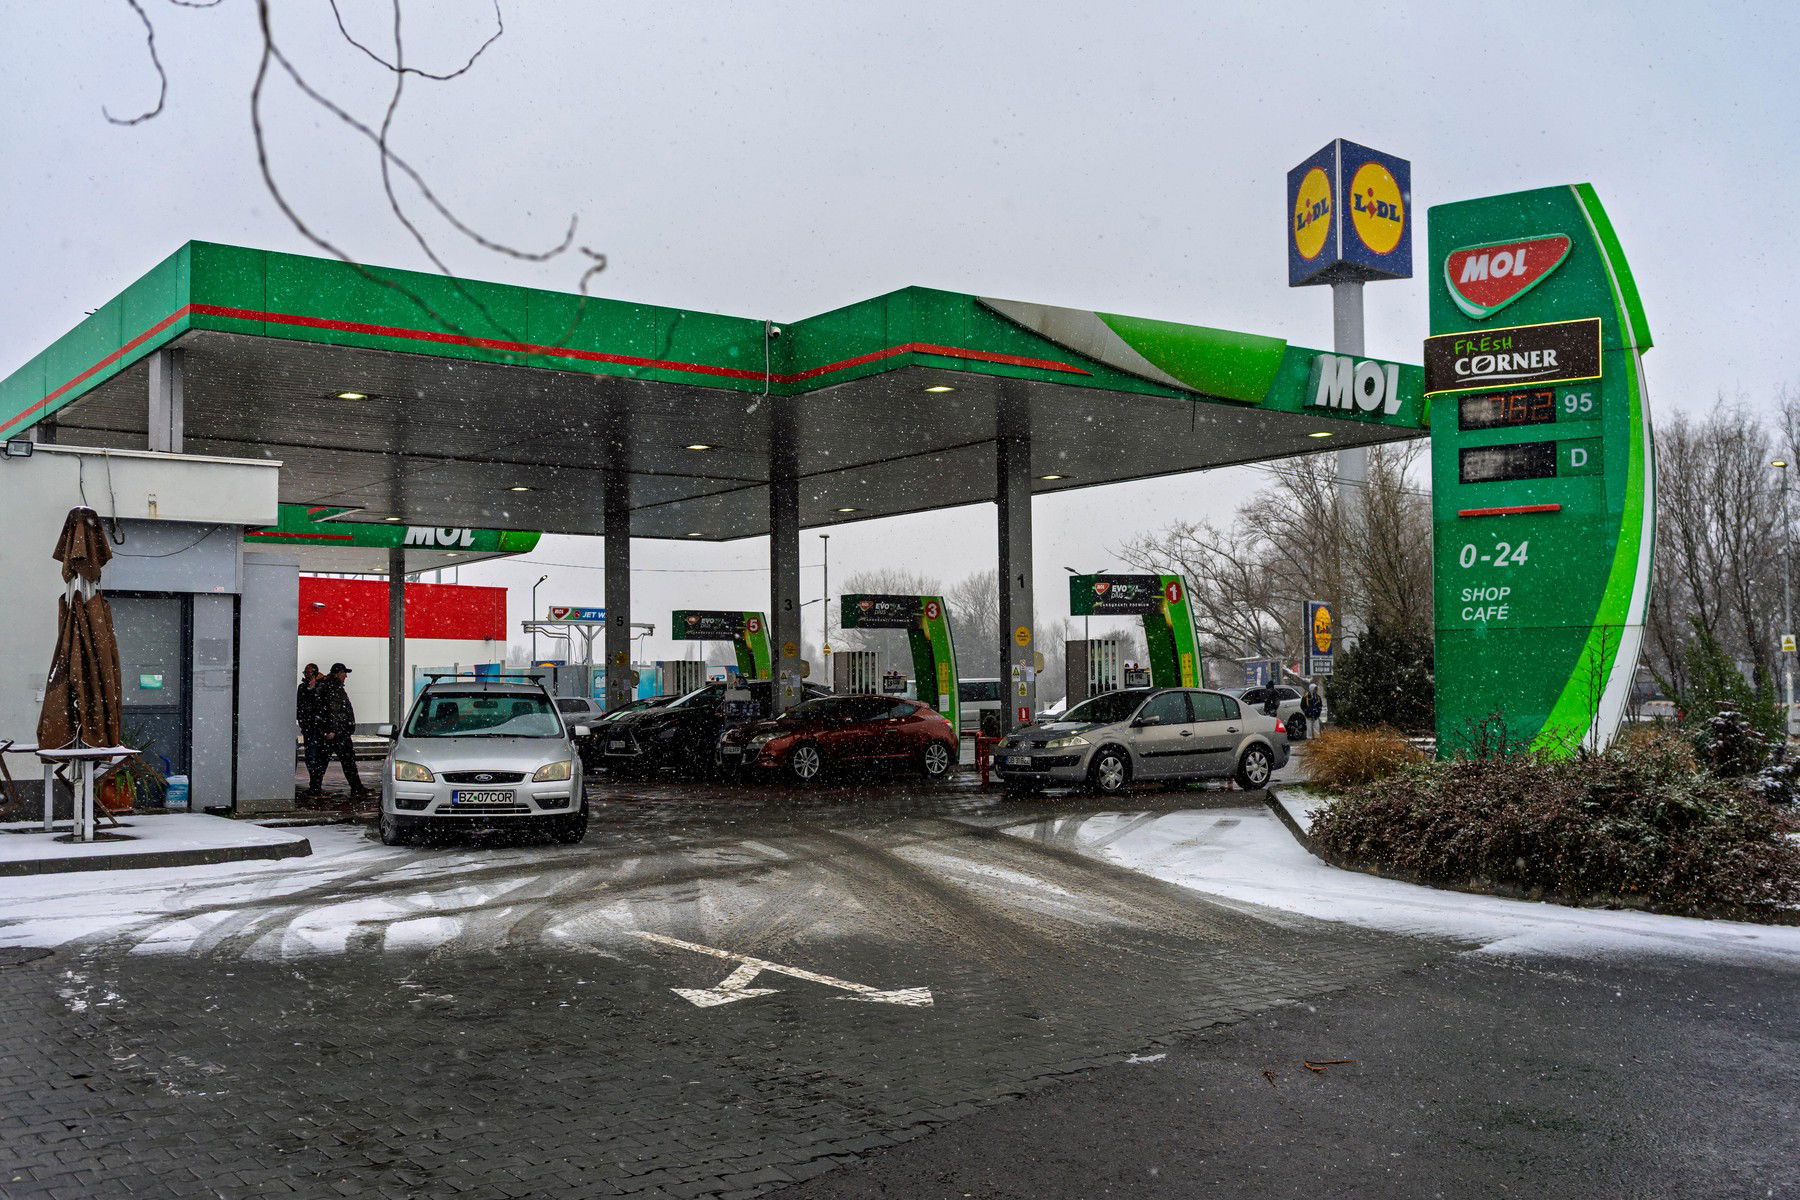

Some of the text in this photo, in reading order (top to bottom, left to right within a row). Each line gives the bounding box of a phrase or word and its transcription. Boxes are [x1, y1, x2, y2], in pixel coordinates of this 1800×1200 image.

[1460, 248, 1528, 283] MOL
[1454, 336, 1513, 355] FRESH
[1454, 348, 1559, 376] CORNER
[1309, 353, 1403, 415] MOL
[1564, 392, 1593, 413] 95
[1571, 448, 1588, 467] D
[403, 525, 476, 547] MOL
[1459, 540, 1529, 568] 0-24
[1017, 573, 1025, 588] 1
[1111, 584, 1127, 593] EVO
[1169, 584, 1178, 601] 1
[1460, 586, 1511, 602] SHOP
[784, 599, 793, 611] 3
[927, 602, 938, 618] 3
[1461, 602, 1510, 621] CAFÉ
[616, 616, 624, 627] 5
[749, 619, 759, 632] 5
[458, 792, 513, 803] BZ 07COR
